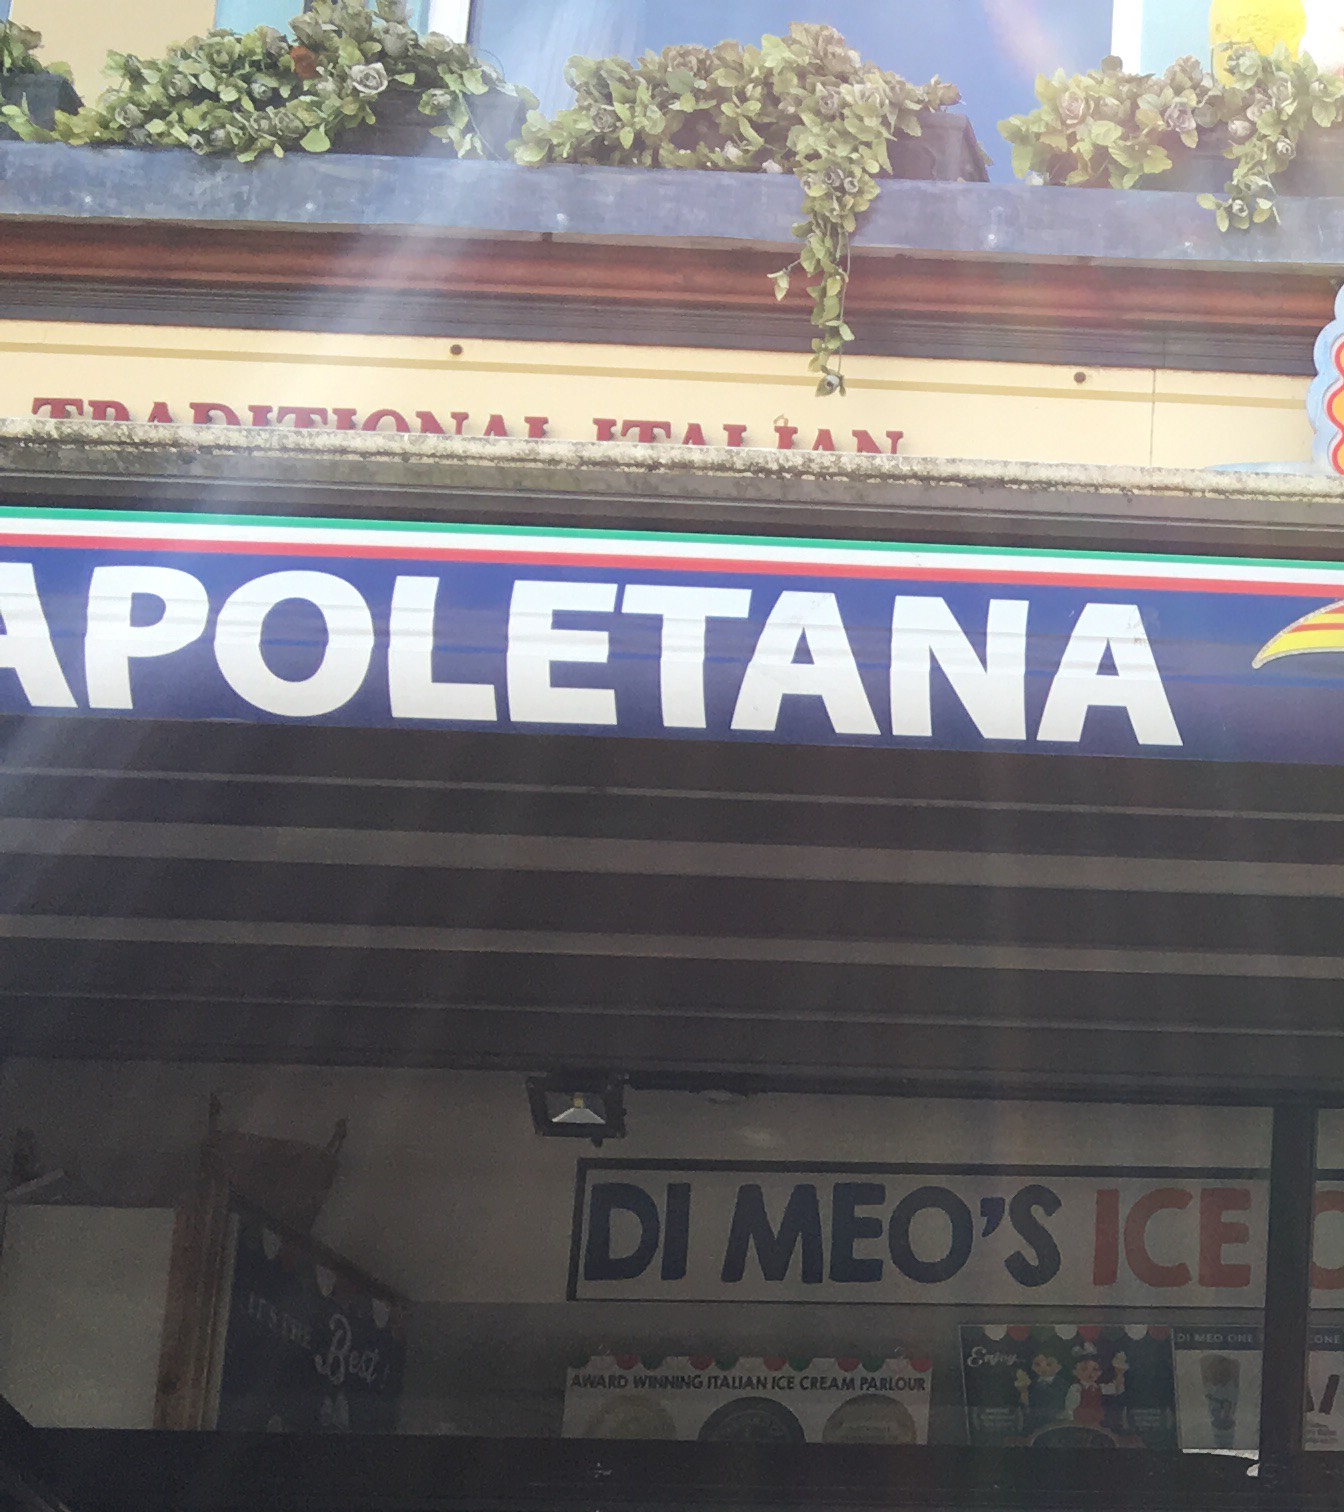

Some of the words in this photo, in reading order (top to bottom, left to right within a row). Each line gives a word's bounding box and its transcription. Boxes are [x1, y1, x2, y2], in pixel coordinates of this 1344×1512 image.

[584, 1181, 688, 1282] DI
[720, 1183, 1062, 1288] MEO'S
[1092, 1187, 1252, 1288] ICE
[570, 1374, 629, 1389] AWARD
[633, 1374, 704, 1389] WINNING
[707, 1375, 768, 1390] ITALIAN
[771, 1376, 795, 1390] ICE
[799, 1376, 855, 1391] CREAM
[859, 1376, 926, 1392] PARLOUR
